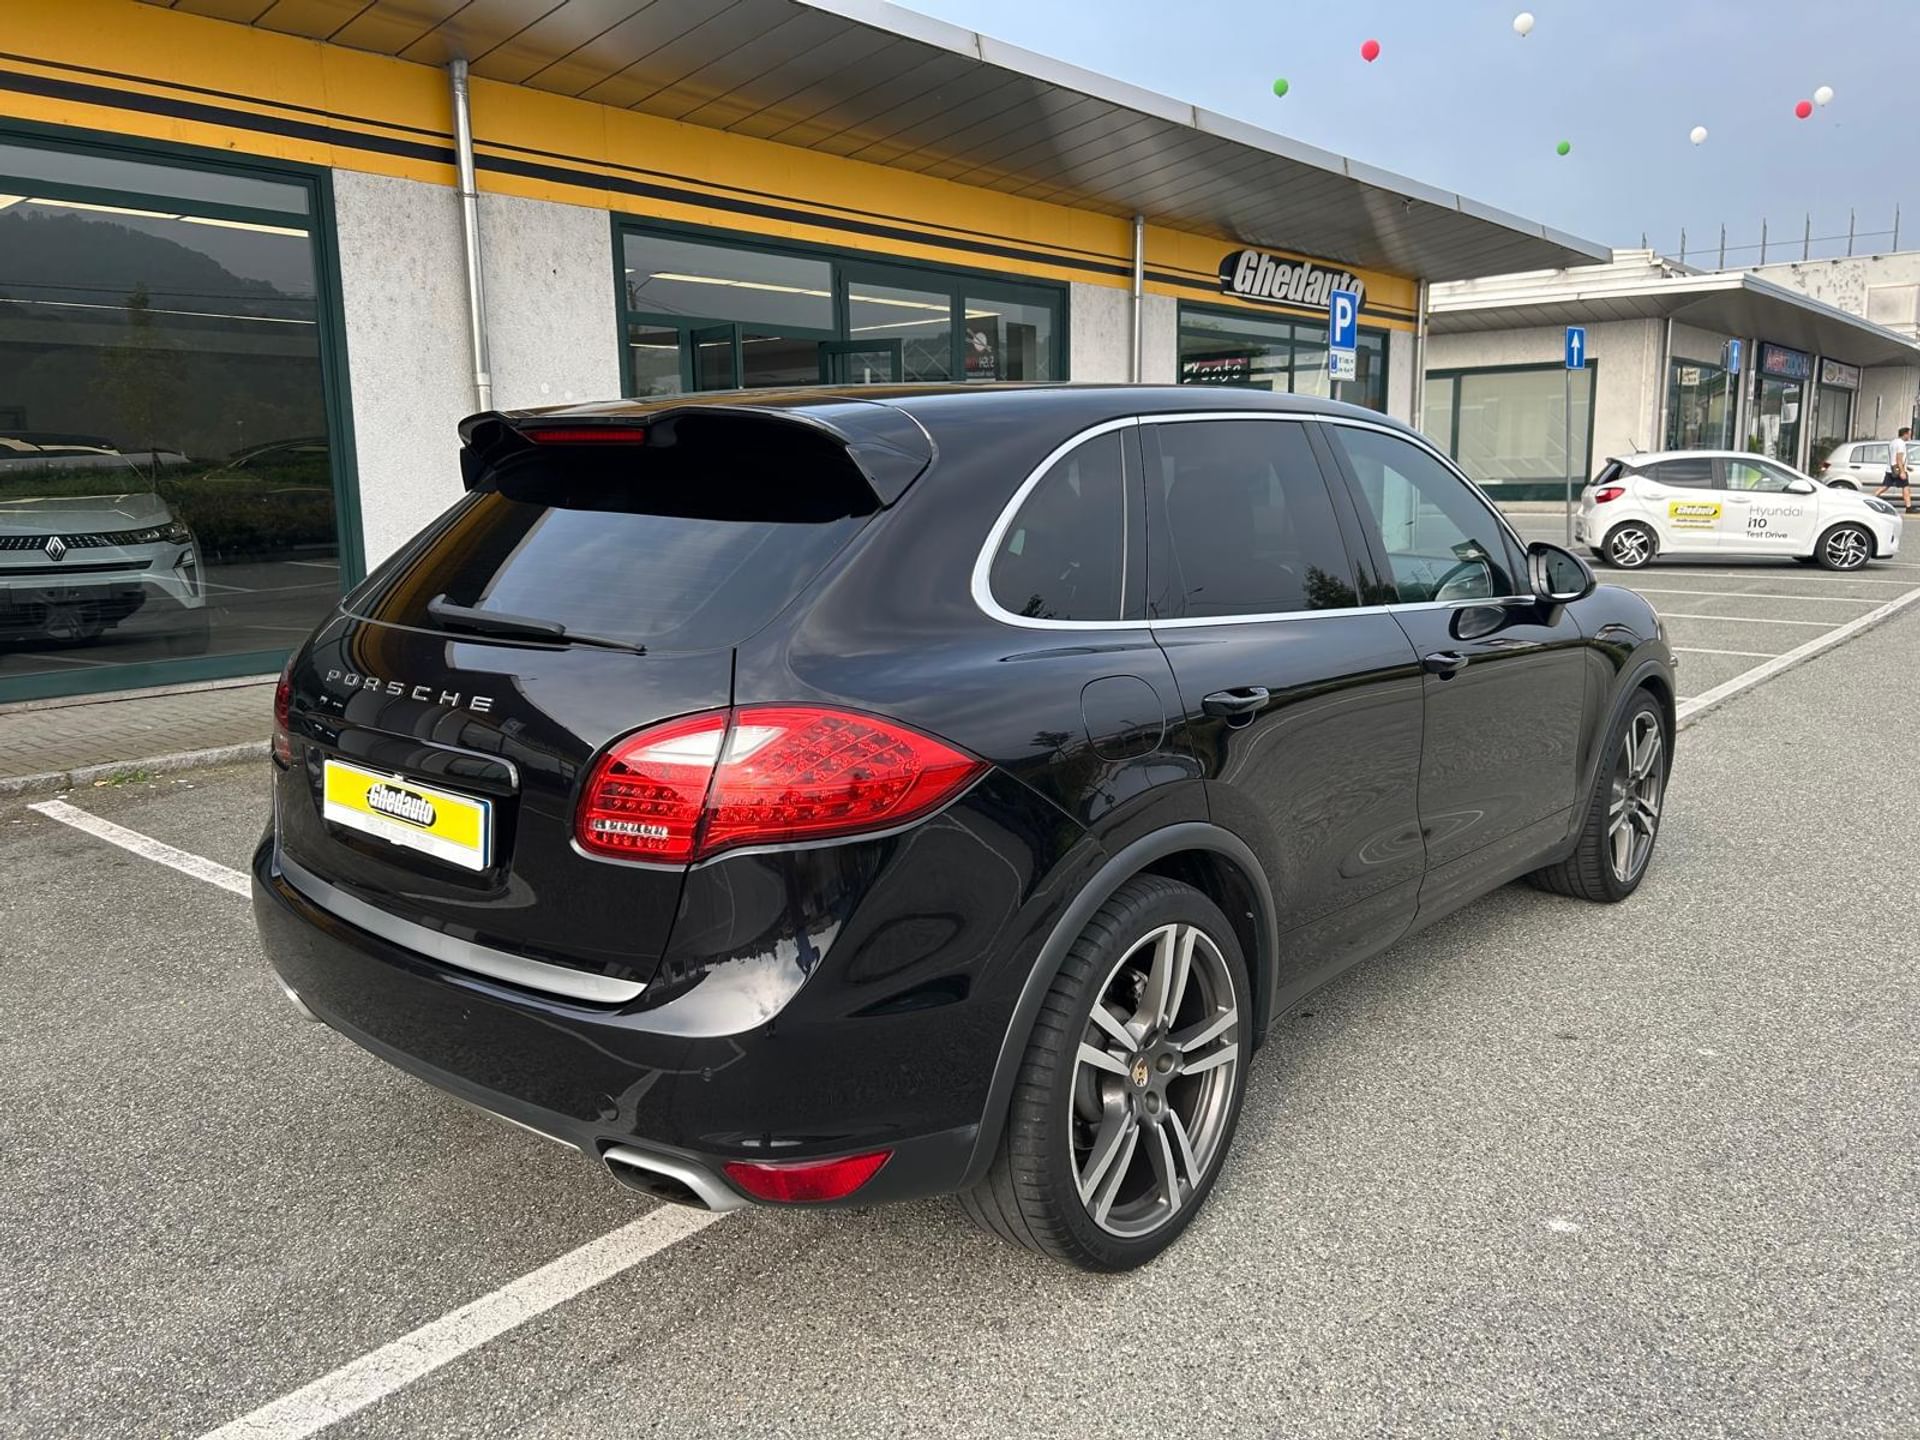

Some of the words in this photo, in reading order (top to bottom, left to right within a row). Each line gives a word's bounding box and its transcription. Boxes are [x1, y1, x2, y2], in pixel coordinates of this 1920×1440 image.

[1234, 250, 1365, 306] Ghedauto
[1335, 297, 1353, 342] P
[1747, 517, 1768, 529] i10
[1749, 505, 1803, 518] Hyundai
[1746, 530, 1764, 539] Test
[1765, 531, 1788, 539] Drive
[326, 669, 495, 713] PORSCHE
[369, 783, 435, 826] Ghedauto
